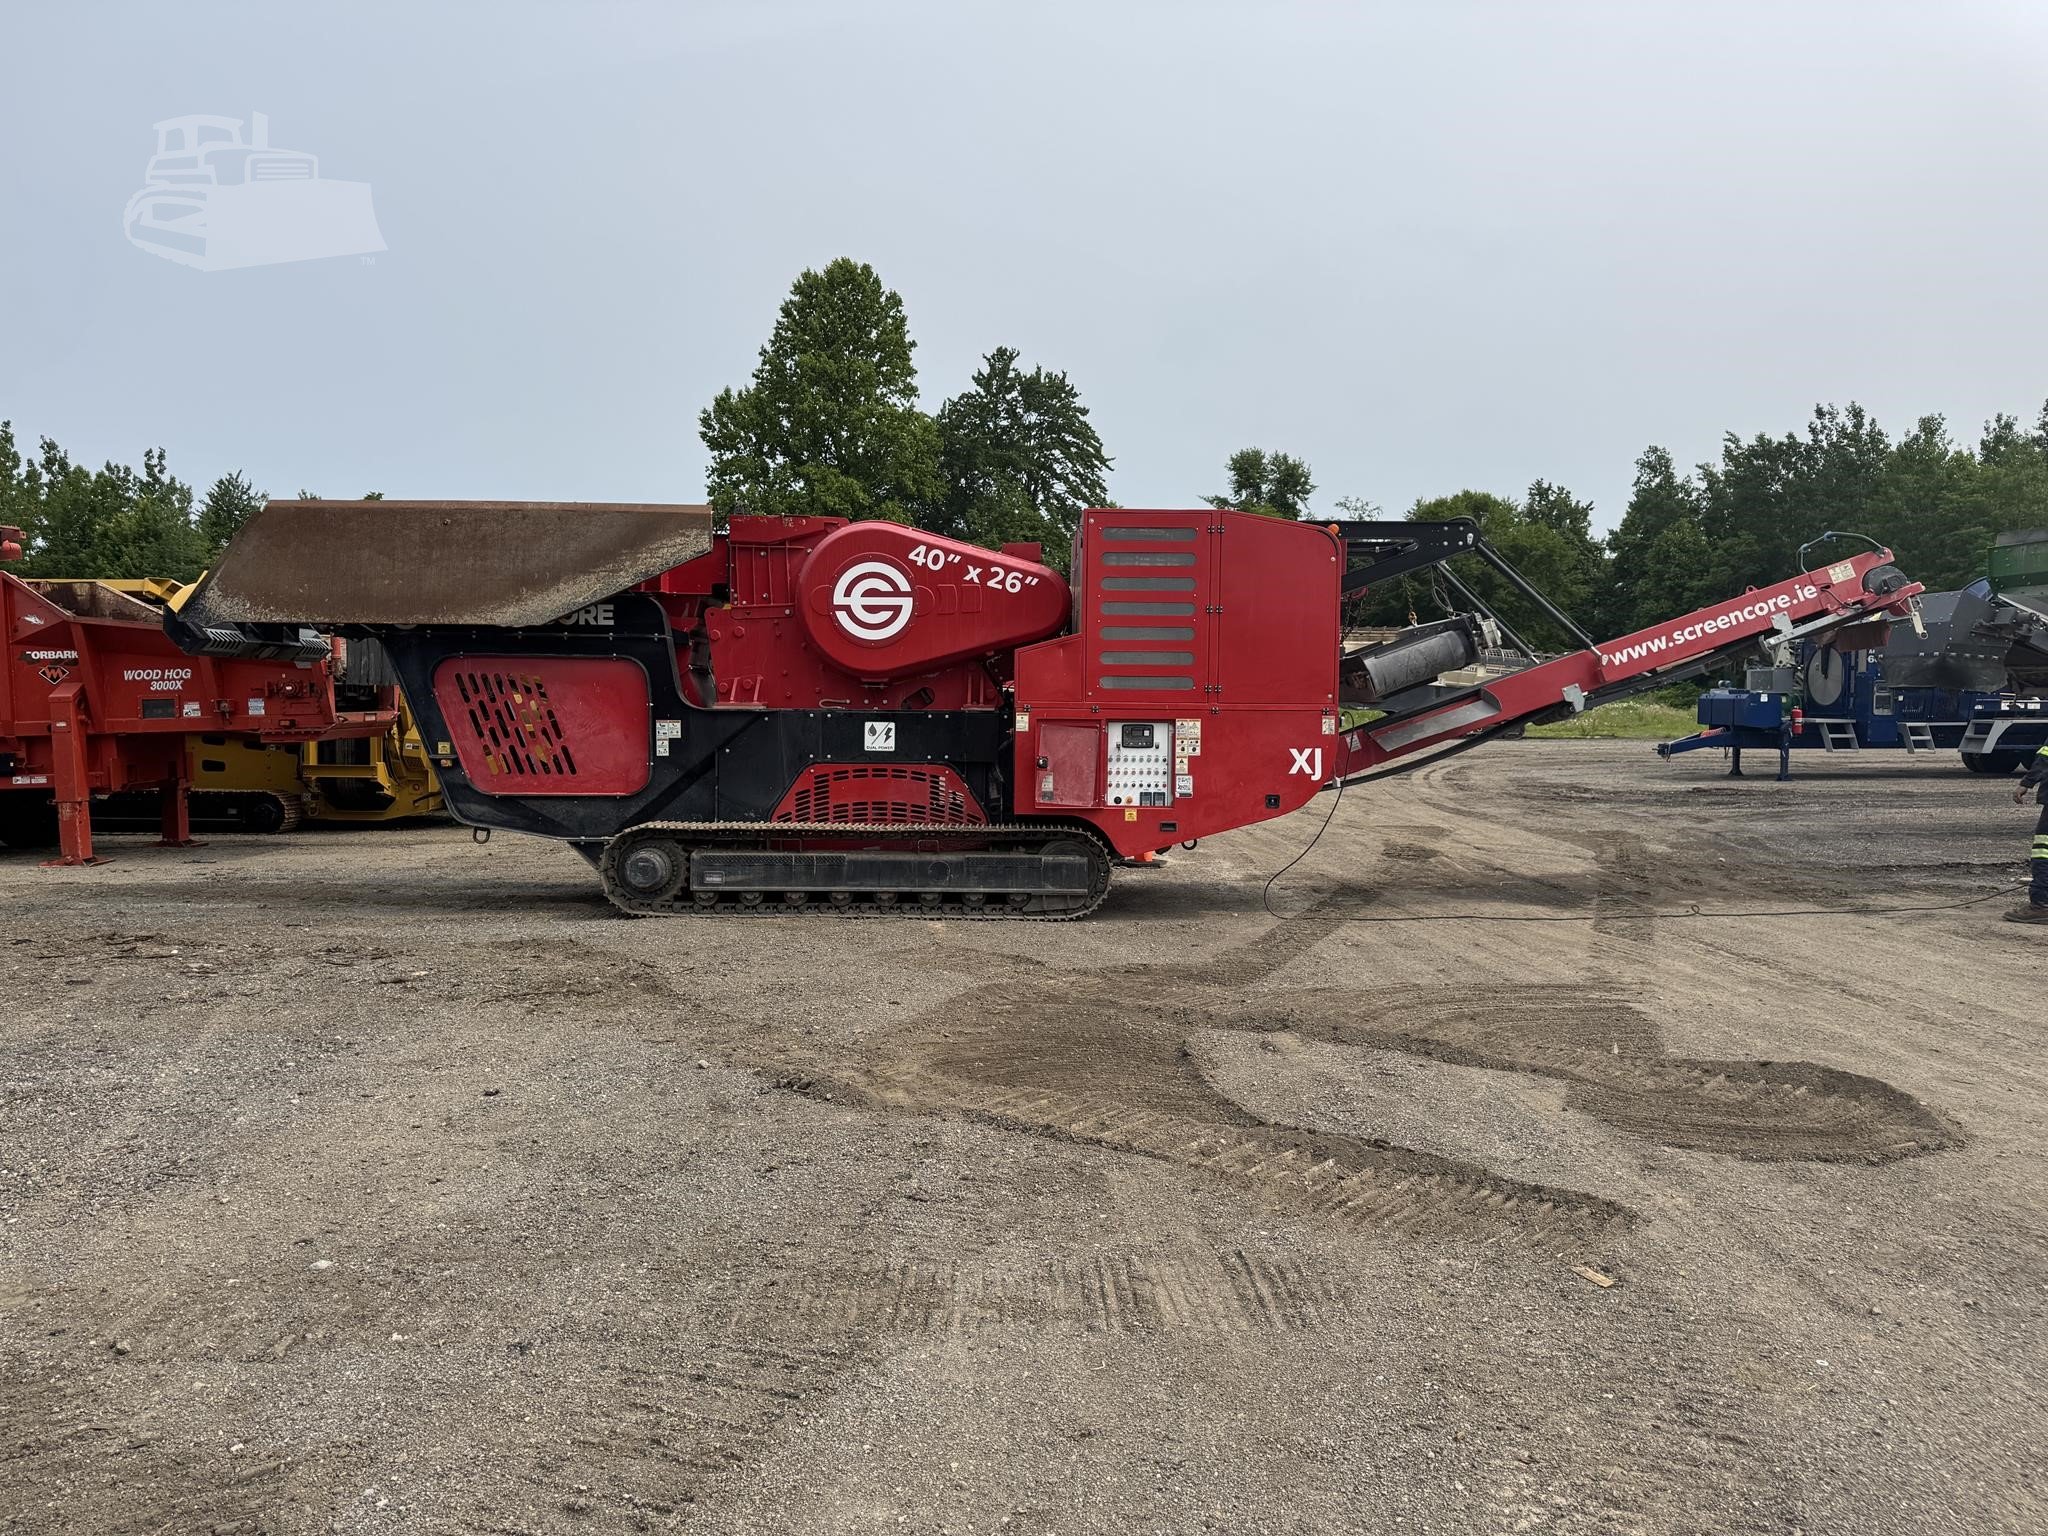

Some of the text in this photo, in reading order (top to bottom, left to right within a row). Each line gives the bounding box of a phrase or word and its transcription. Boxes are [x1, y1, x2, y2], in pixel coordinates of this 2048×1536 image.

[908, 545, 1039, 593] 40" x 26"
[1609, 584, 1818, 666] www.screencore.ie
[26, 650, 79, 660] ORBARK
[123, 668, 192, 680] WOOD HOG
[150, 680, 184, 691] 3000X
[1288, 747, 1322, 781] XJ
